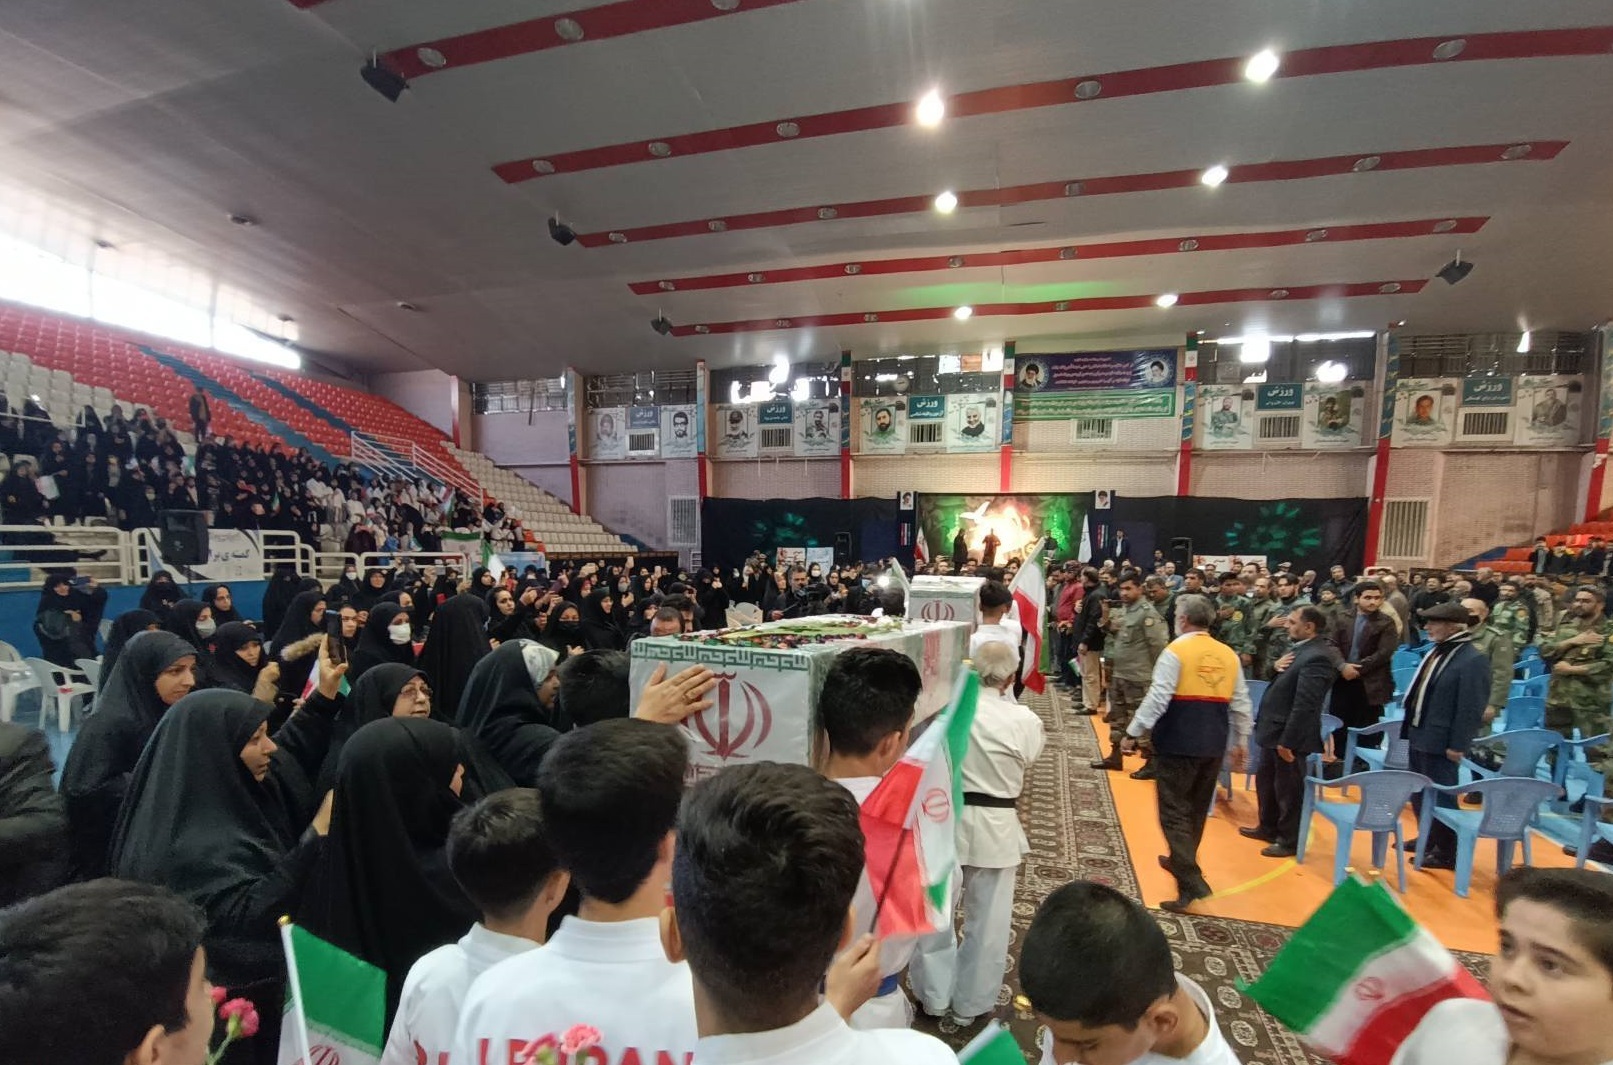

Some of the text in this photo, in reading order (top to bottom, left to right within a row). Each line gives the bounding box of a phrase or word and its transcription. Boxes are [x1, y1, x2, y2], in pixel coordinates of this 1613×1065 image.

[1267, 386, 1294, 397] ورزش
[1473, 381, 1503, 392] ورزش
[916, 398, 939, 408] ورزش
[766, 404, 786, 413] ورزش
